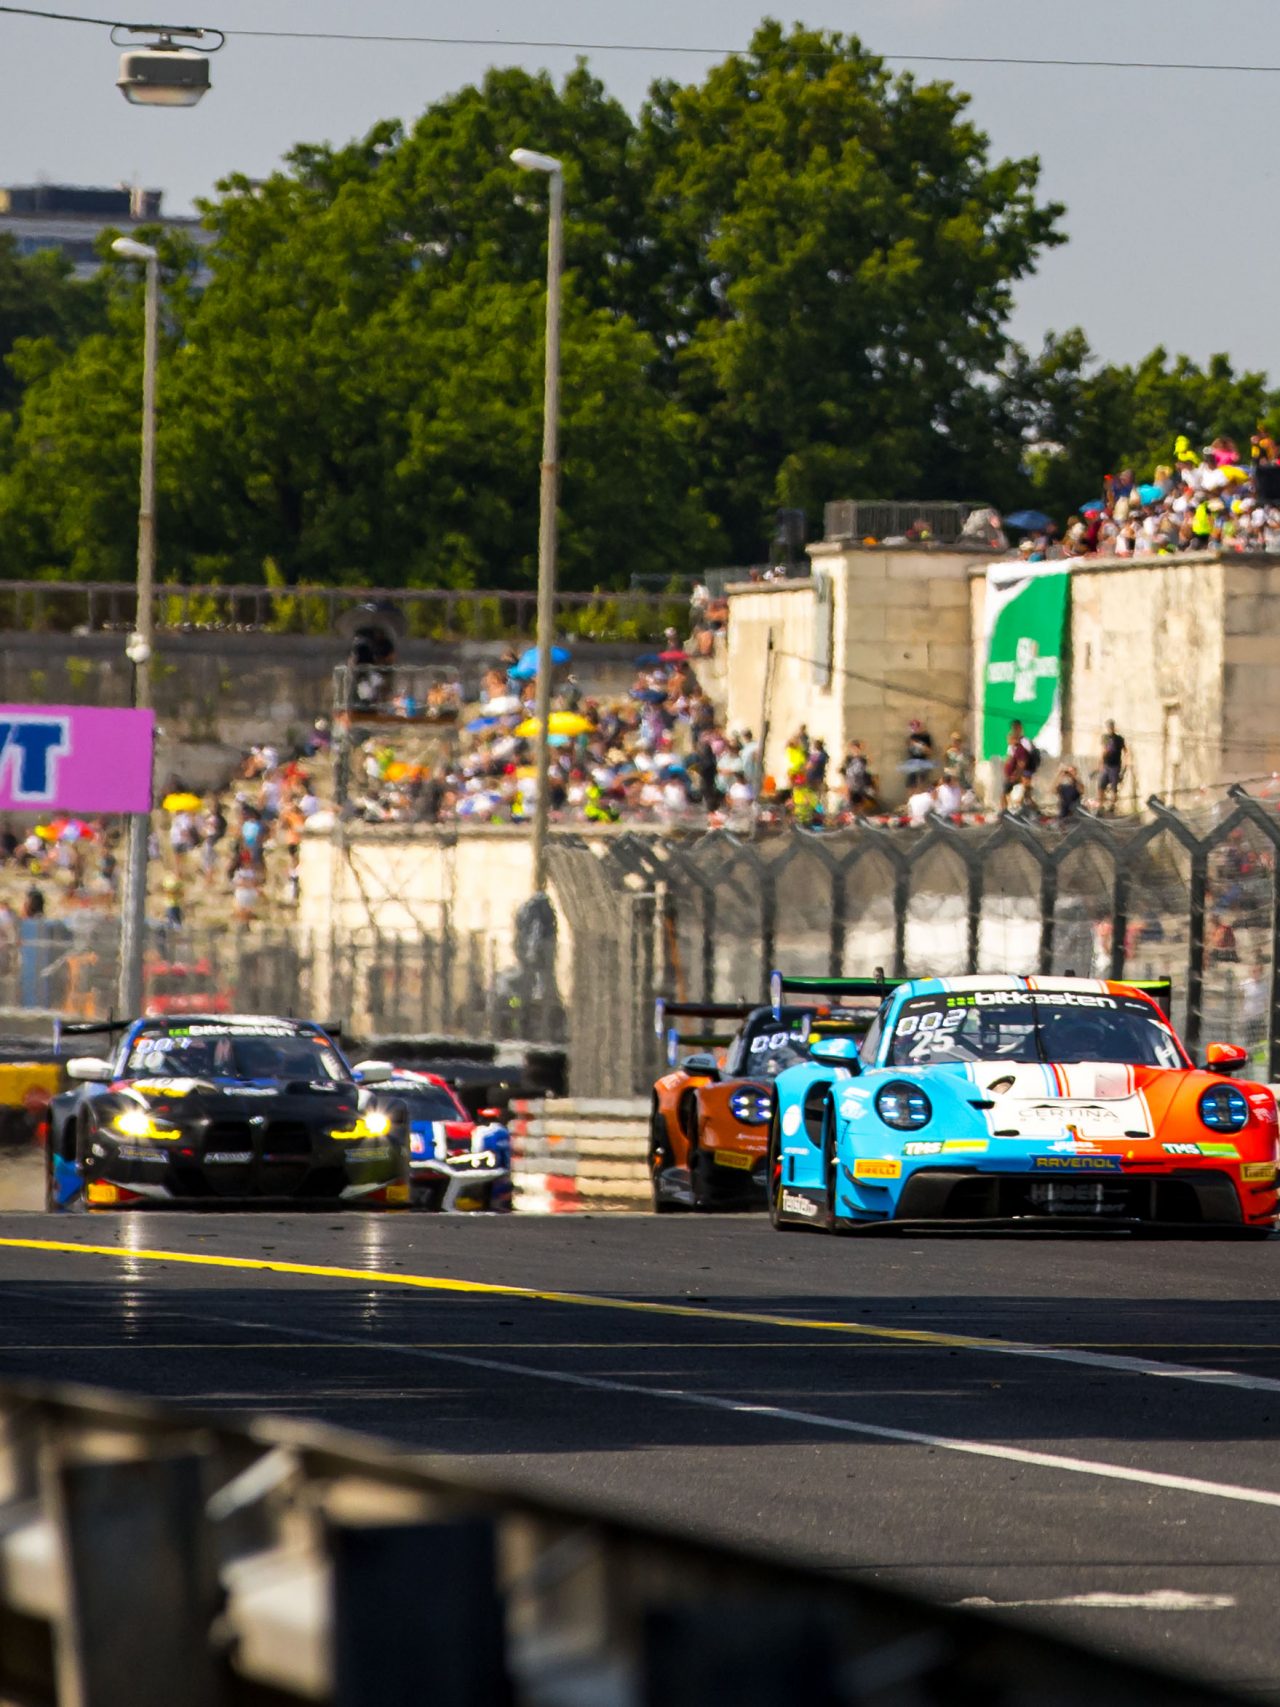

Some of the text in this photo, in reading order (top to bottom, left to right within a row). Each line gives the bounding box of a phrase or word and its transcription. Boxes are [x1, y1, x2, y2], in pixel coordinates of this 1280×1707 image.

[974, 991, 1118, 1009] bitkasten
[896, 1009, 967, 1037] 002
[909, 1027, 958, 1058] 25
[1036, 1157, 1116, 1168] RAVENOL
